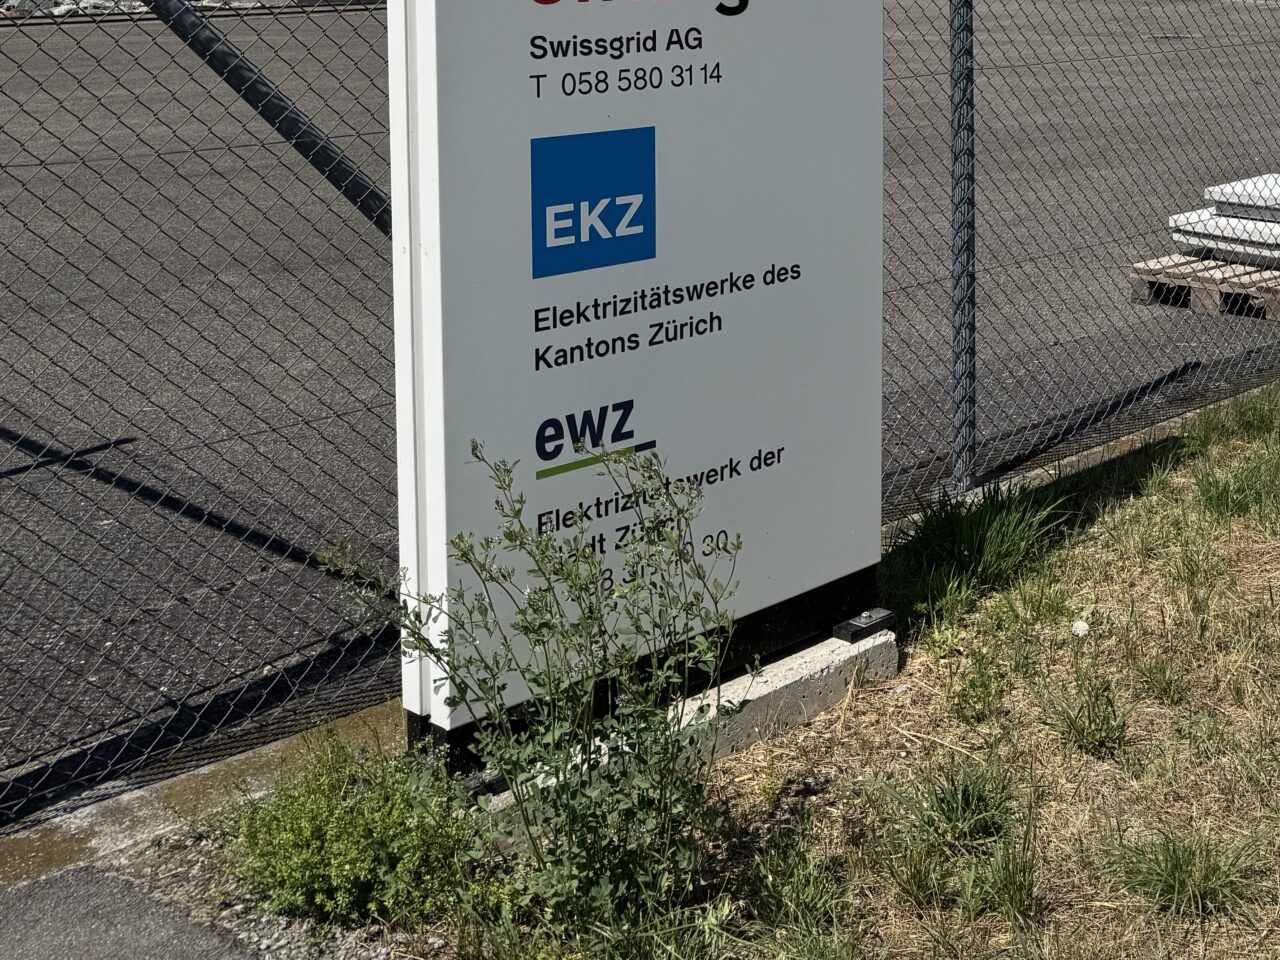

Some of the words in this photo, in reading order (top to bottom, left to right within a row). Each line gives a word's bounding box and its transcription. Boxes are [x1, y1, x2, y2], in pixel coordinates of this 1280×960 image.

[529, 30, 657, 60] Swissgrid
[666, 27, 702, 51] AG
[529, 75, 547, 98] T
[561, 71, 609, 96] 058
[617, 67, 662, 91] 580
[546, 194, 644, 248] EKZ
[534, 272, 755, 332] Elektrizitätswerke
[763, 263, 801, 286] des
[534, 333, 640, 371] Kantons
[648, 311, 722, 346] Zürich
[535, 399, 635, 461] ewz
[537, 457, 741, 536] Elektrizttswerk
[750, 447, 785, 472] der
